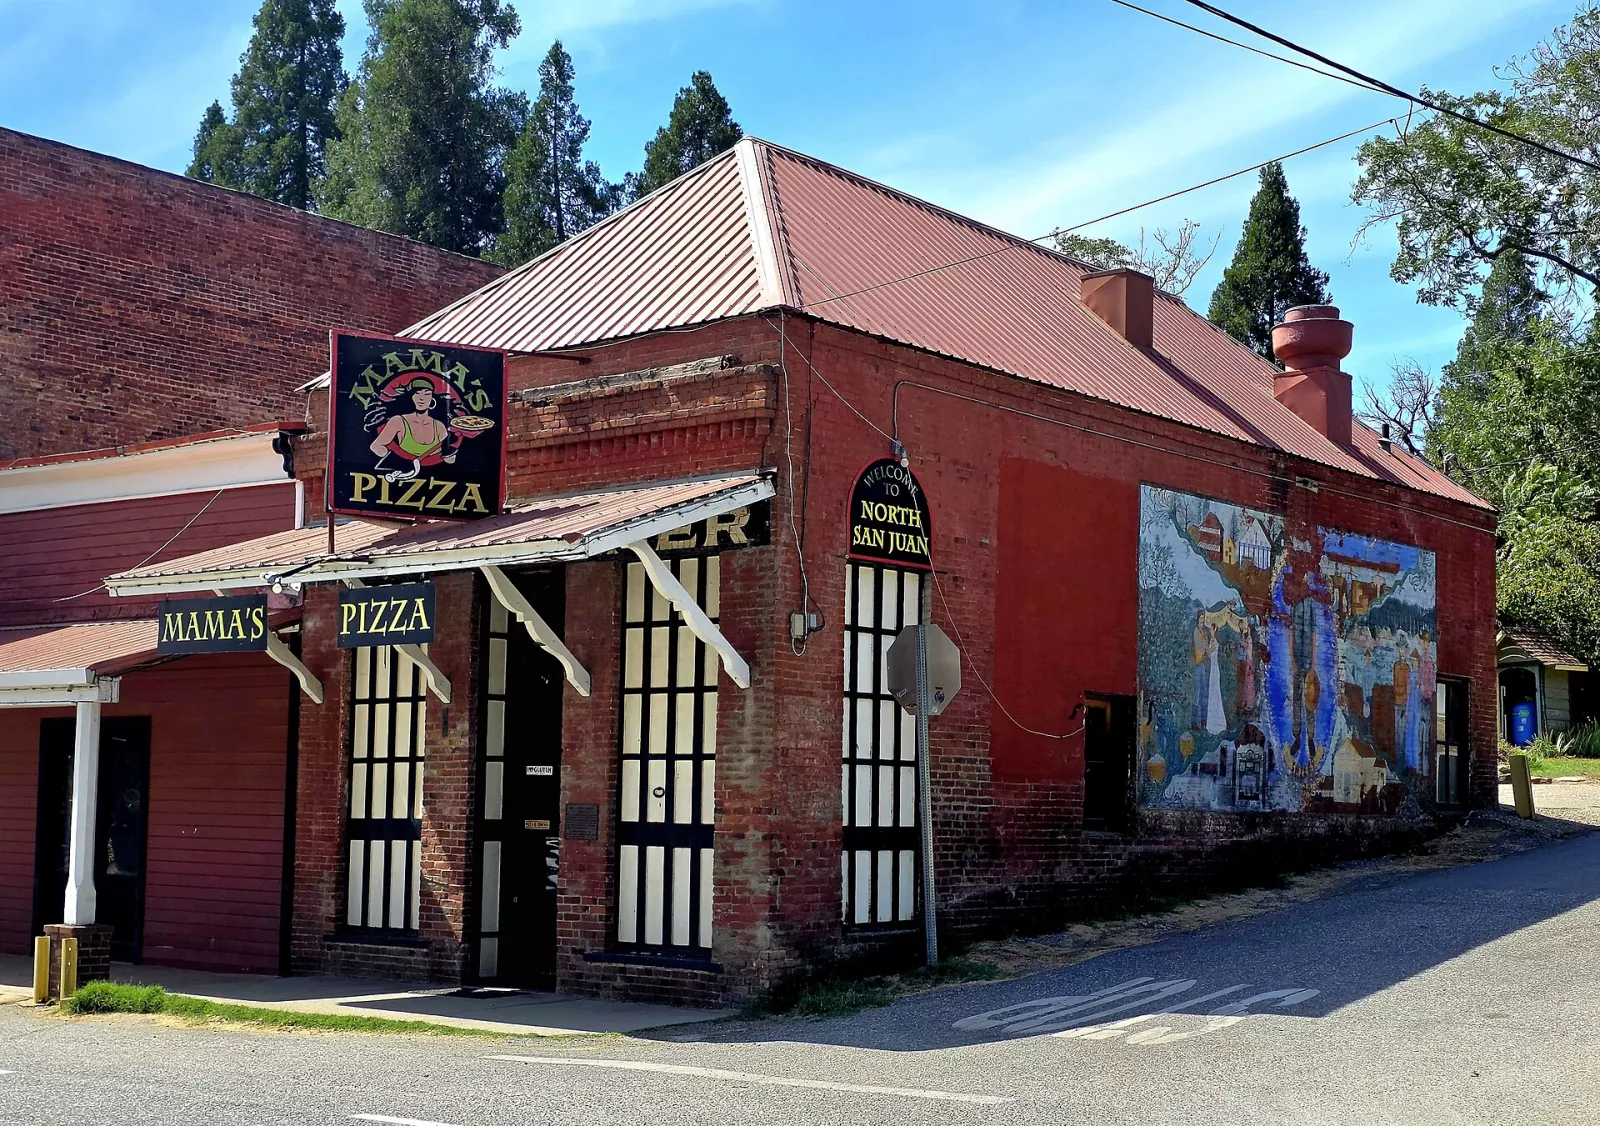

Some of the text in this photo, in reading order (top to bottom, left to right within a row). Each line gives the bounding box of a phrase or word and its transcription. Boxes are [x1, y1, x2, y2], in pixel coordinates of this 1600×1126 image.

[348, 348, 493, 411] MAMA'S
[348, 472, 489, 514] PIZZA
[863, 464, 919, 494] WELCOME
[883, 482, 900, 497] TO
[860, 500, 921, 528] NORTH
[852, 524, 929, 556] SAN JUAN
[161, 605, 264, 642] MAMA'S
[340, 596, 431, 637] PIZZA
